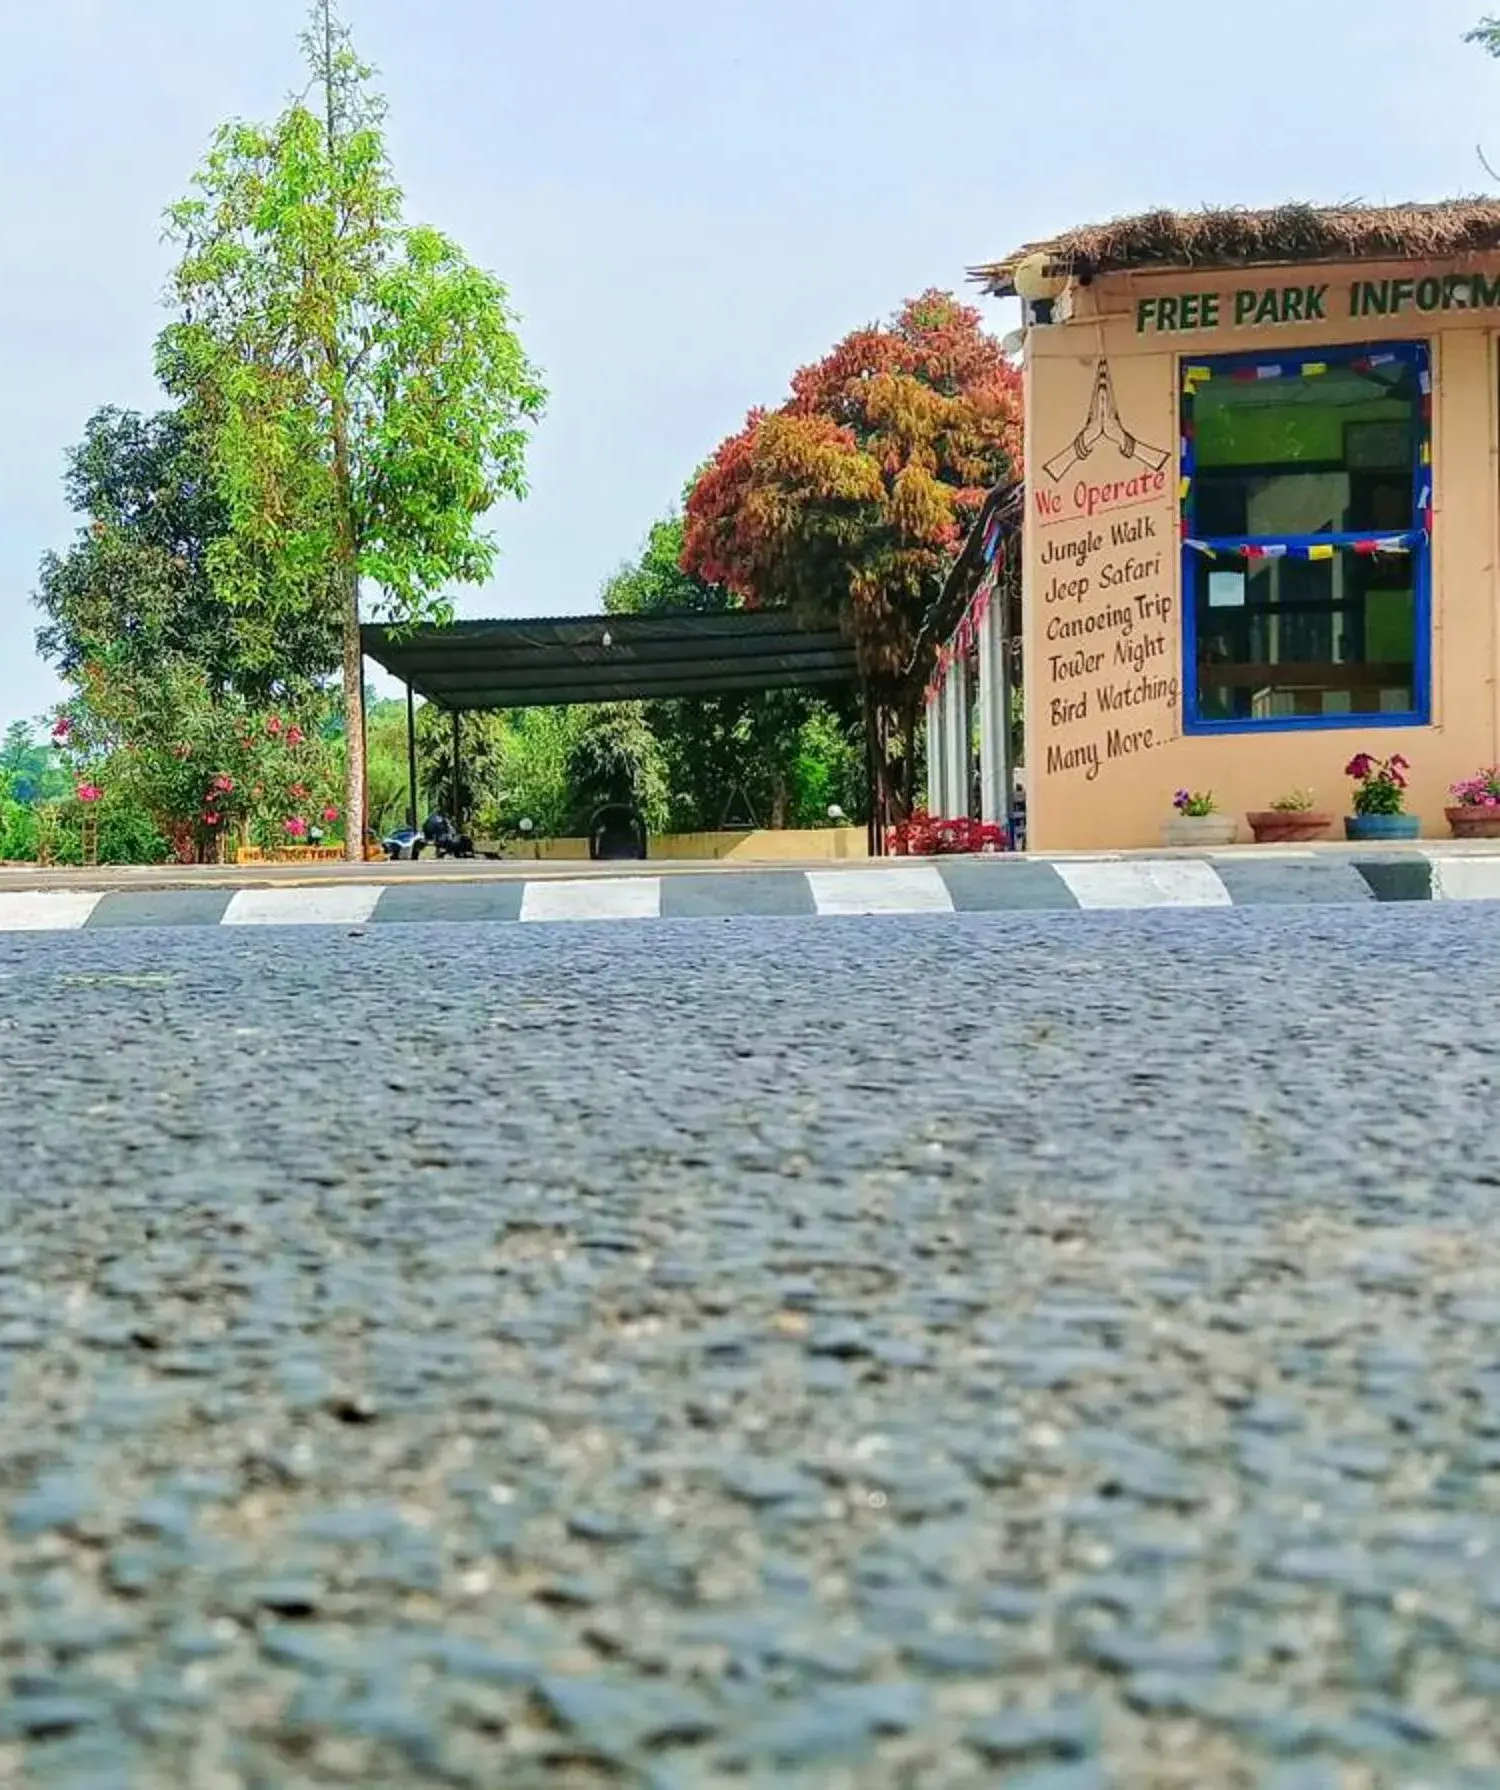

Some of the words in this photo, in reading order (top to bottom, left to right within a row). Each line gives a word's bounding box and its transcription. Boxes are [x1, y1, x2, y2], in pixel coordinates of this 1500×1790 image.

[1136, 292, 1219, 332] FREE
[1234, 284, 1329, 324] PARK
[1035, 489, 1062, 514] We
[1074, 469, 1165, 516] Operate
[1041, 531, 1103, 566] Jungle
[1110, 516, 1156, 546] Walk
[1045, 577, 1089, 603] Jeep
[1099, 551, 1161, 589] Safari
[1046, 604, 1134, 641] Canoeing
[1134, 594, 1172, 623] Trip
[1048, 650, 1105, 683] Tower
[1113, 632, 1166, 673] Night
[1050, 692, 1088, 726] Bird
[1097, 676, 1178, 708] Watching
[1047, 743, 1102, 781] Many
